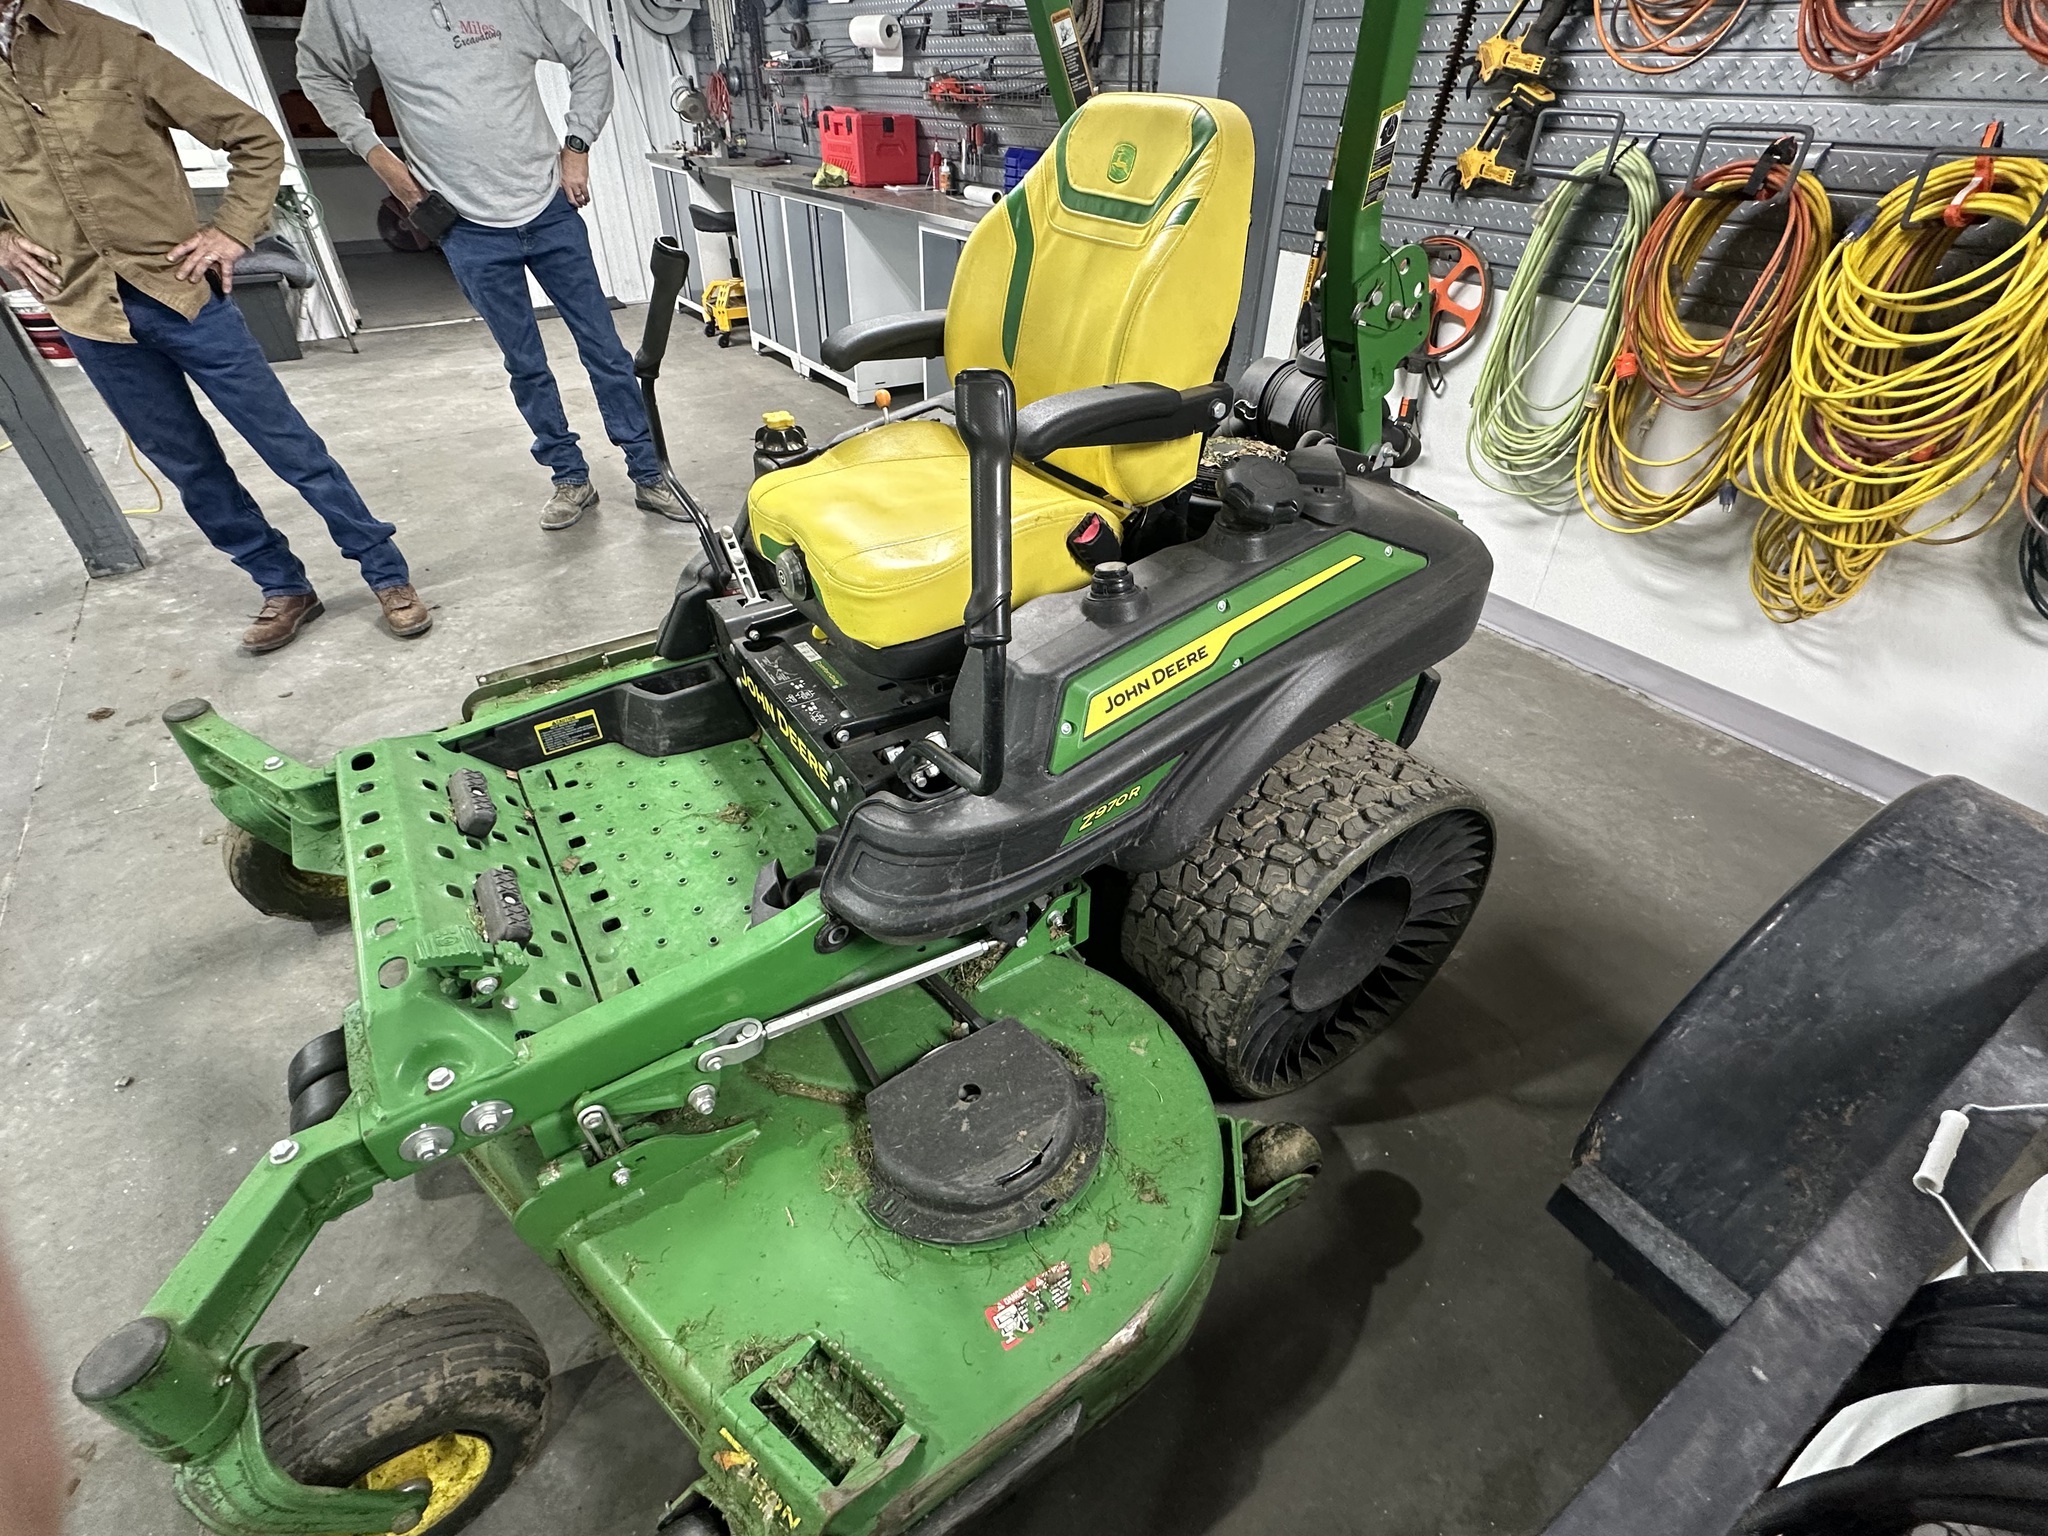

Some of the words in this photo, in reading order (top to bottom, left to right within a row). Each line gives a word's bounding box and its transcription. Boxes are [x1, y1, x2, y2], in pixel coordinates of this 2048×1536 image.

[453, 30, 502, 49] Excavating
[459, 20, 496, 35] Miles
[1105, 678, 1151, 714] JOHN
[1151, 645, 1209, 685] DEERE
[741, 665, 777, 723] JOHN
[776, 707, 831, 791] DEERE
[1079, 785, 1142, 832] Z970R
